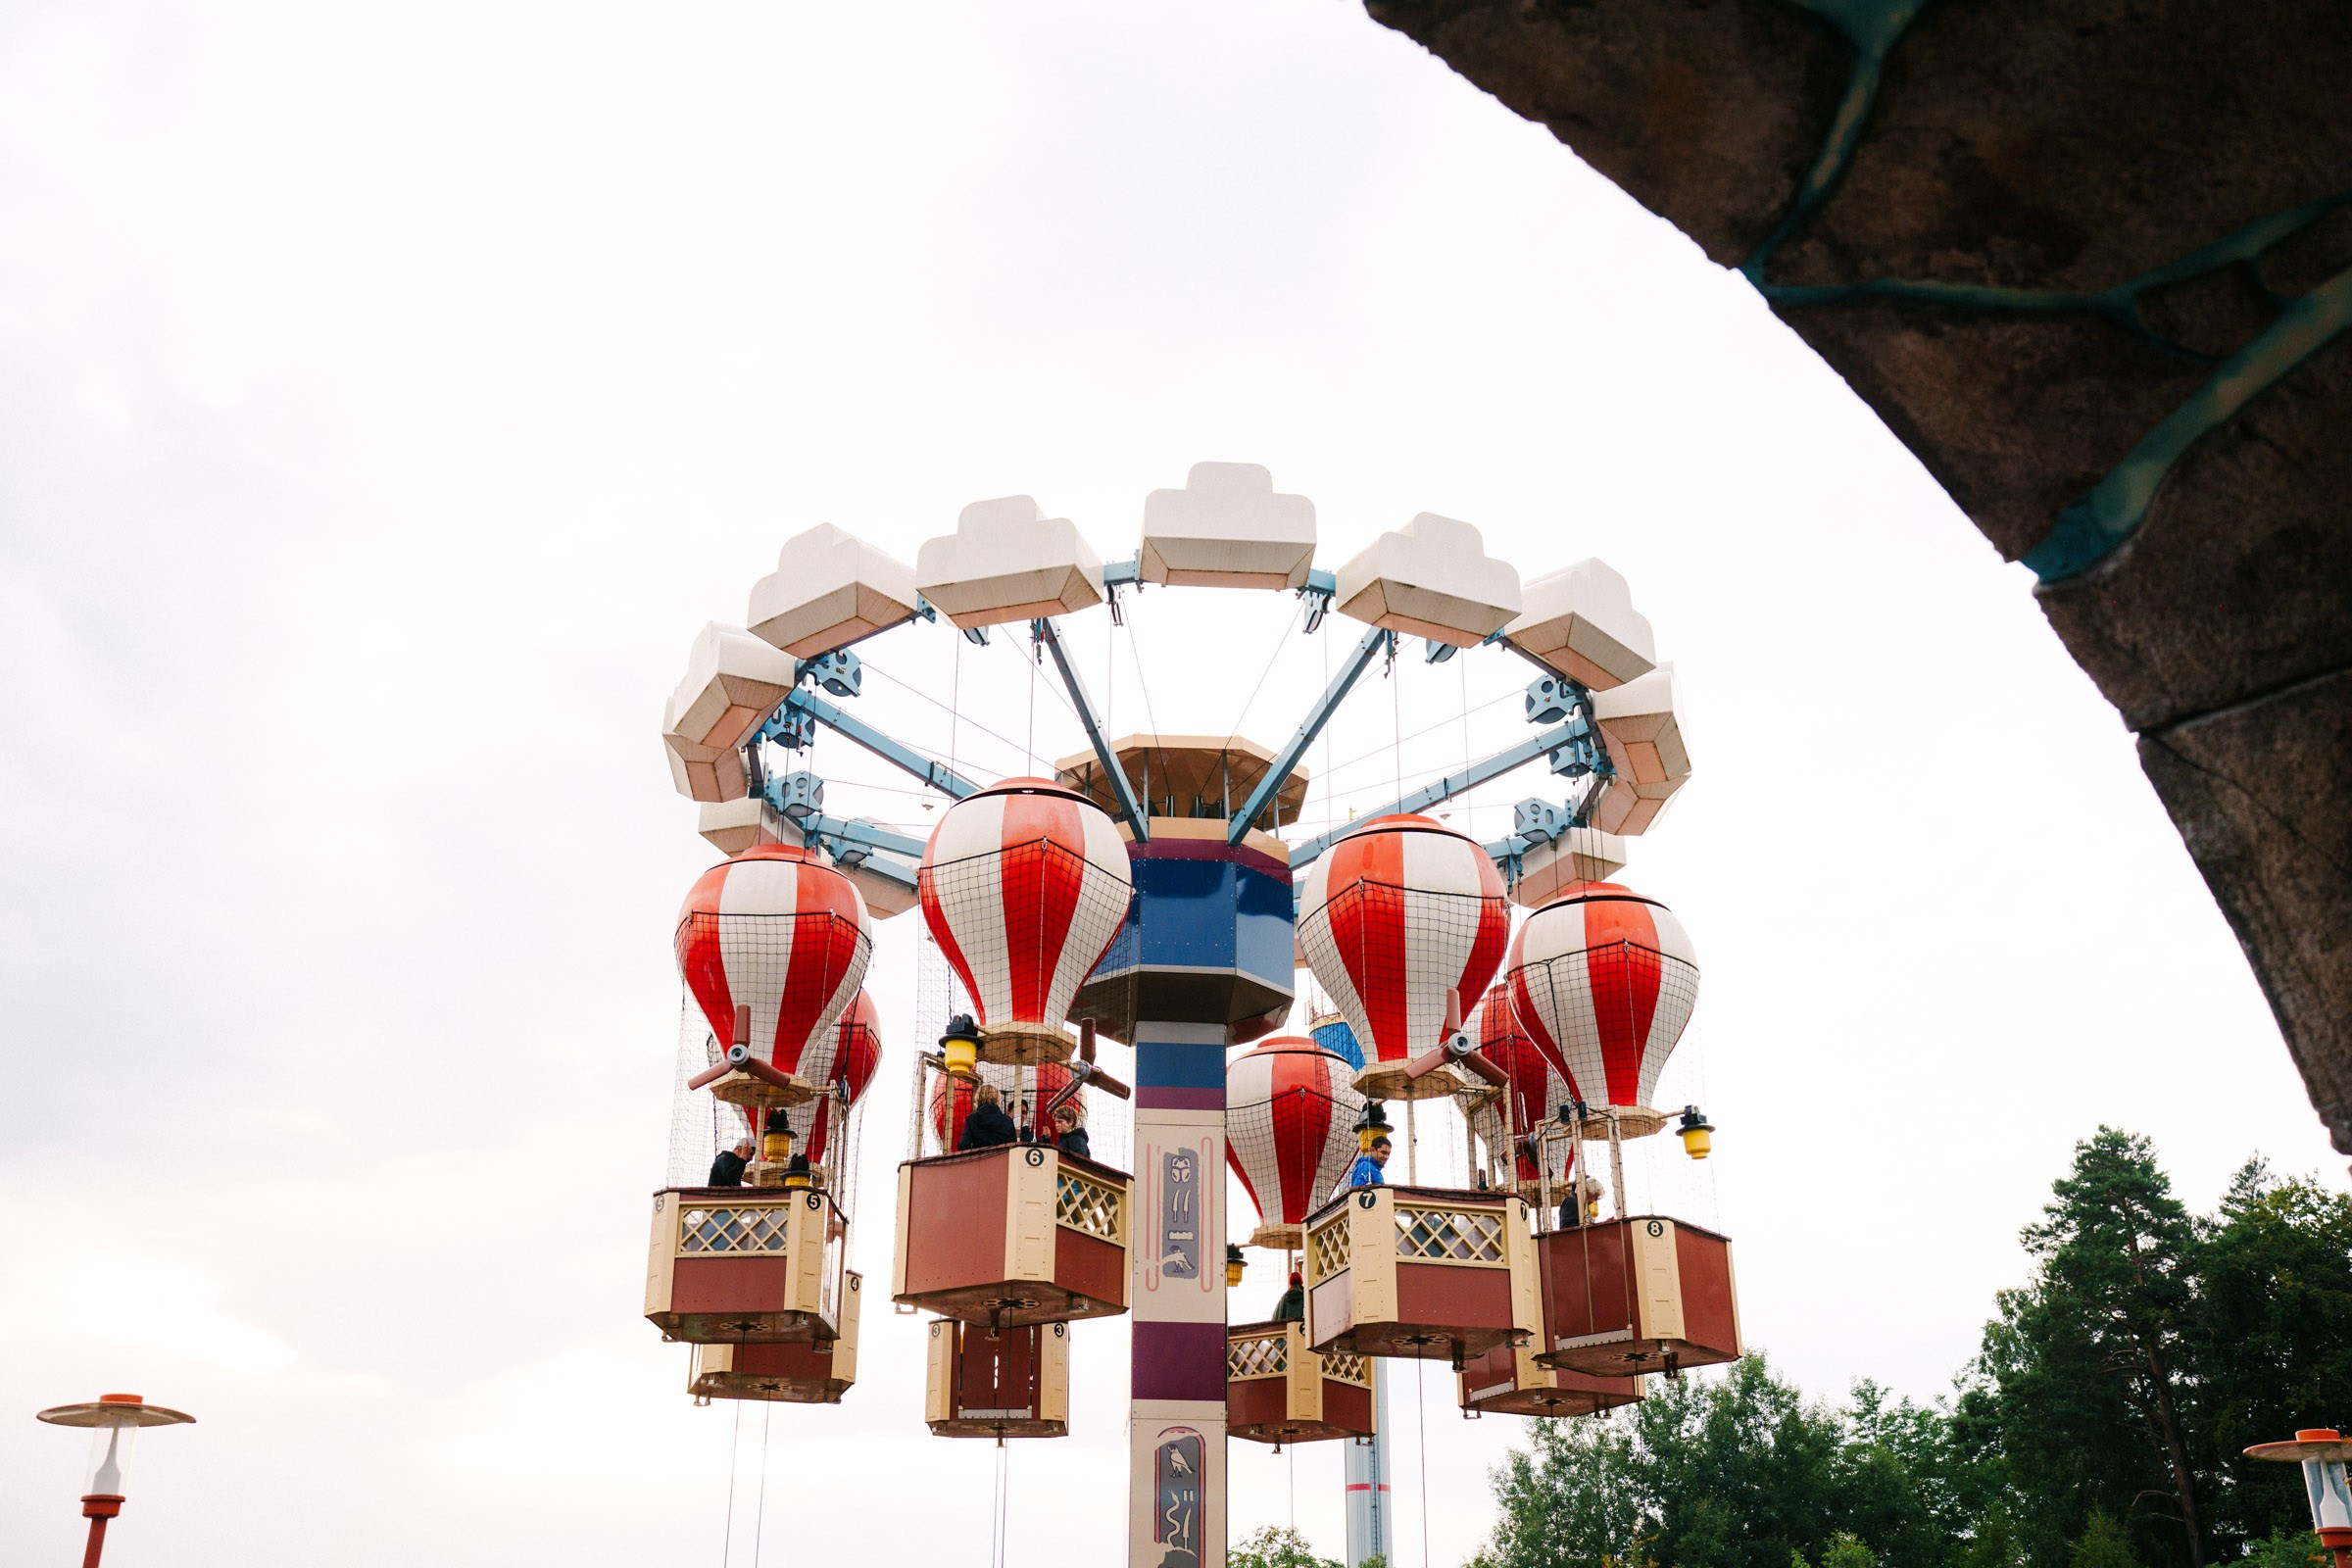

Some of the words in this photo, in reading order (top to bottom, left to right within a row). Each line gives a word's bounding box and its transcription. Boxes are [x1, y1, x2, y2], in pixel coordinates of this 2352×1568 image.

[1029, 1151, 1039, 1164] 6
[809, 1195, 818, 1207] 5
[1362, 1194, 1372, 1207] 7
[1650, 1222, 1660, 1235] 8
